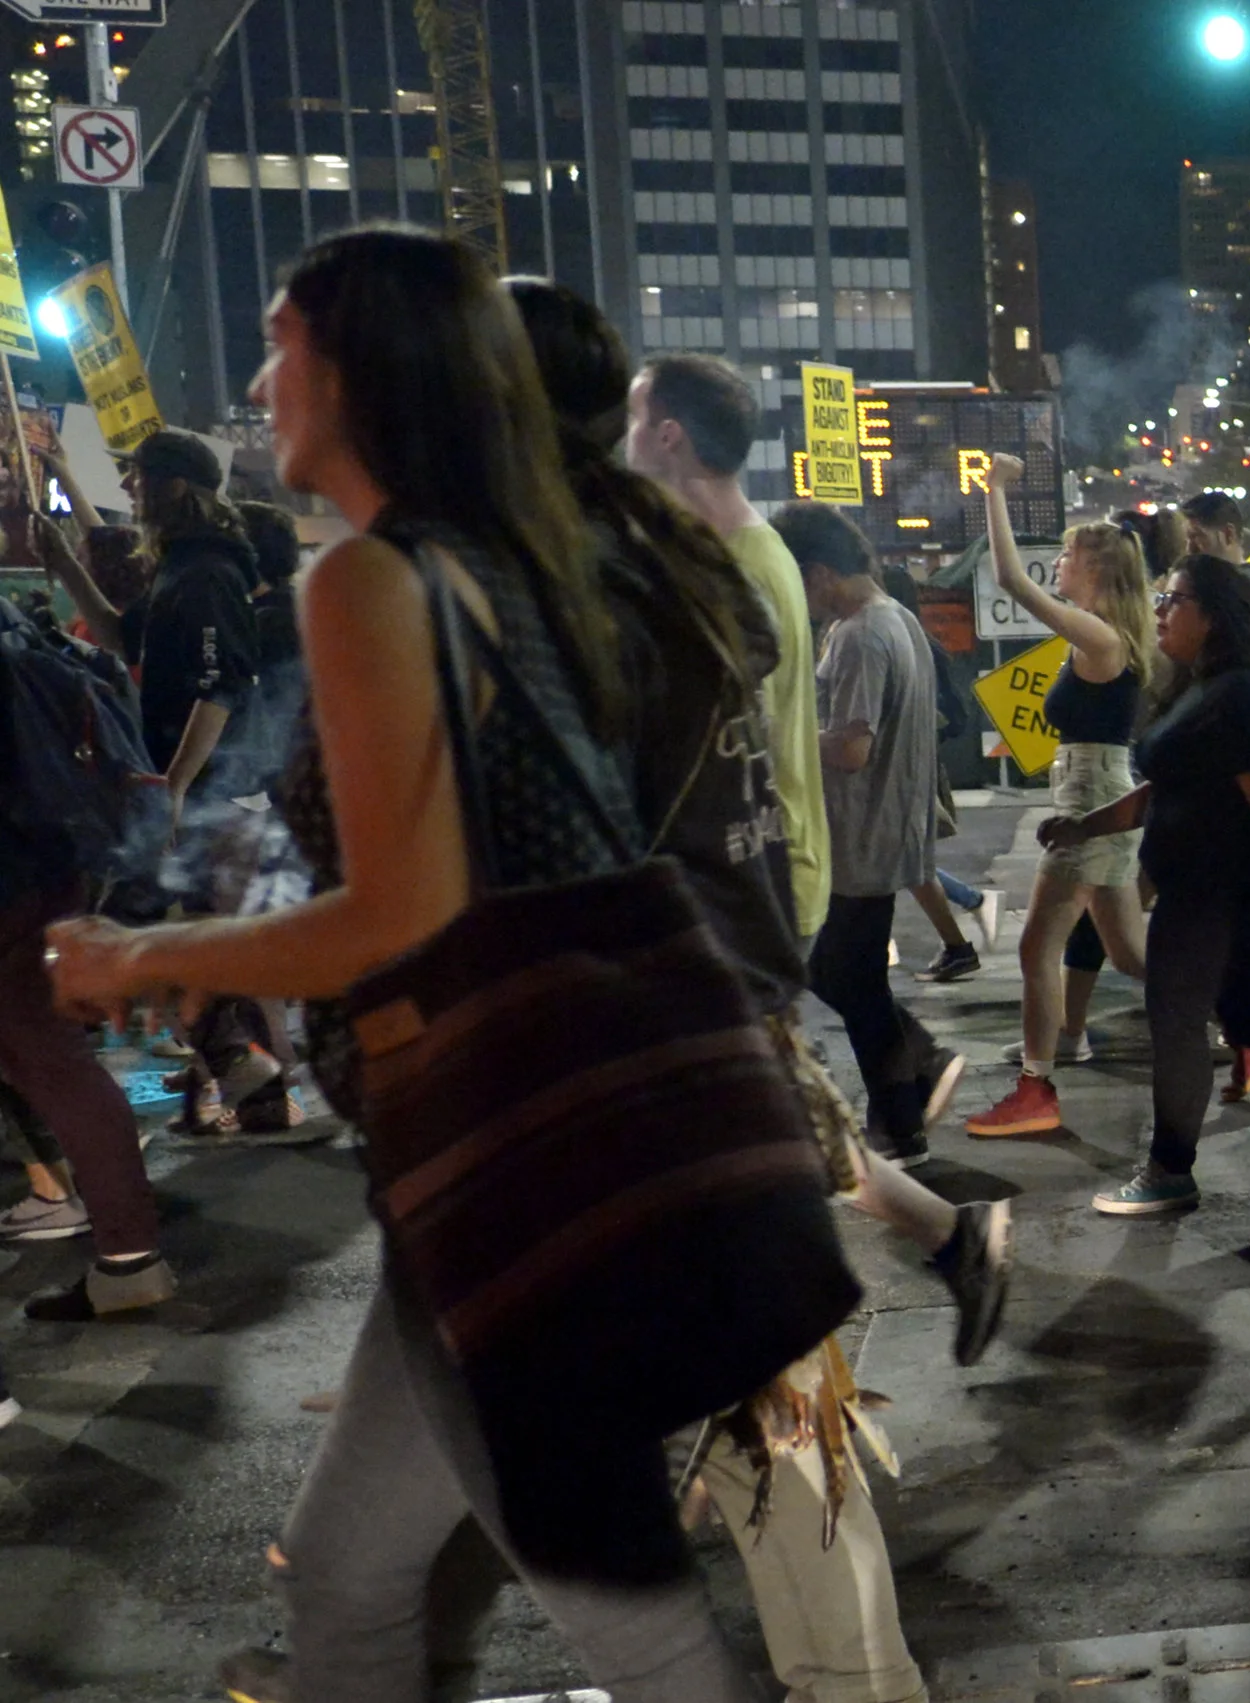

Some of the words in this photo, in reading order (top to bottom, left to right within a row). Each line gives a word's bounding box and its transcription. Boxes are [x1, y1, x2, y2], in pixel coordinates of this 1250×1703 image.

[812, 376, 846, 402] STAND
[812, 405, 849, 431] AGAINST
[1010, 667, 1049, 697] DE
